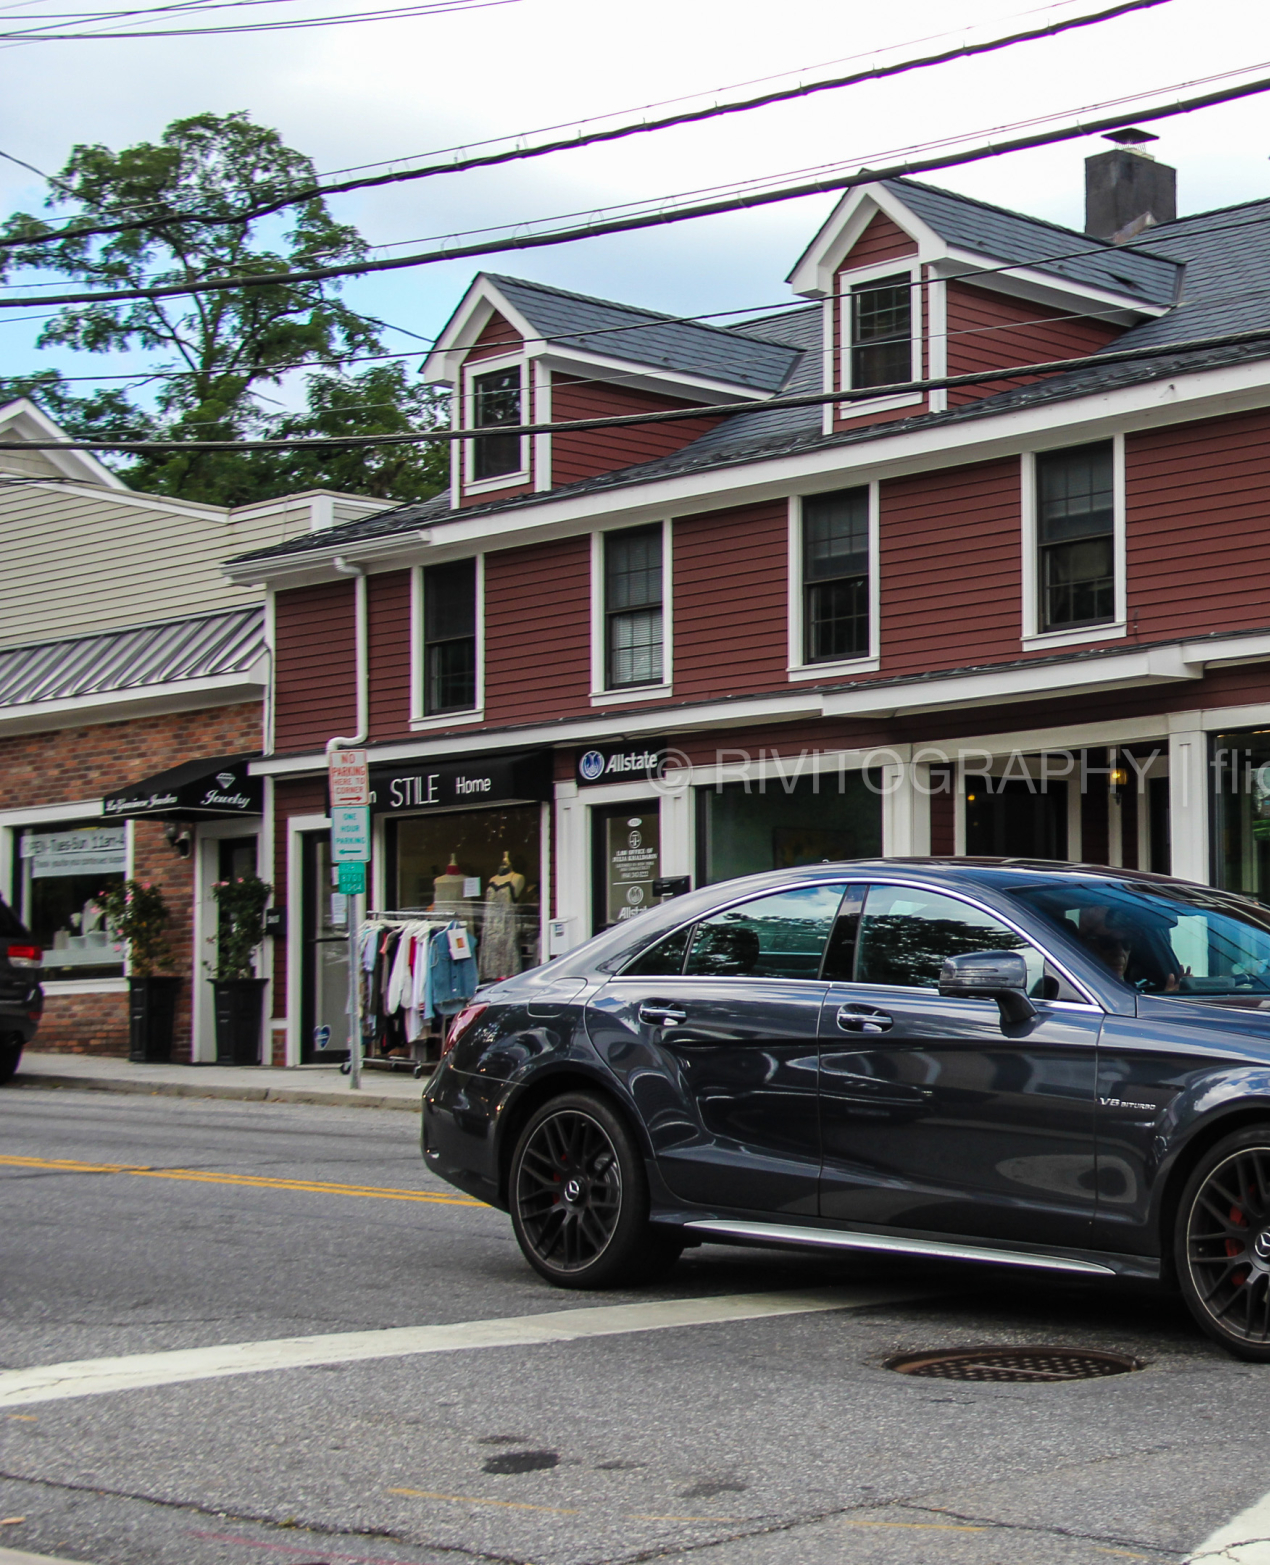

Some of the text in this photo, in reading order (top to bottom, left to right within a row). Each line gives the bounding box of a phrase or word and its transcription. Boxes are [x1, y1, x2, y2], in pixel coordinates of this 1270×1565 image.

[341, 753, 355, 764] NO
[605, 751, 657, 772] Allstate
[331, 766, 366, 777] PARKING
[356, 777, 366, 785] TO
[336, 786, 364, 794] CORNER
[390, 775, 440, 807] STILE
[456, 776, 491, 793] Home
[343, 813, 357, 821] ONE
[340, 825, 360, 833] HOUR
[335, 837, 366, 845] PARKING
[618, 905, 648, 920] Allst
[1100, 1097, 1156, 1110] V8 BITURBO
